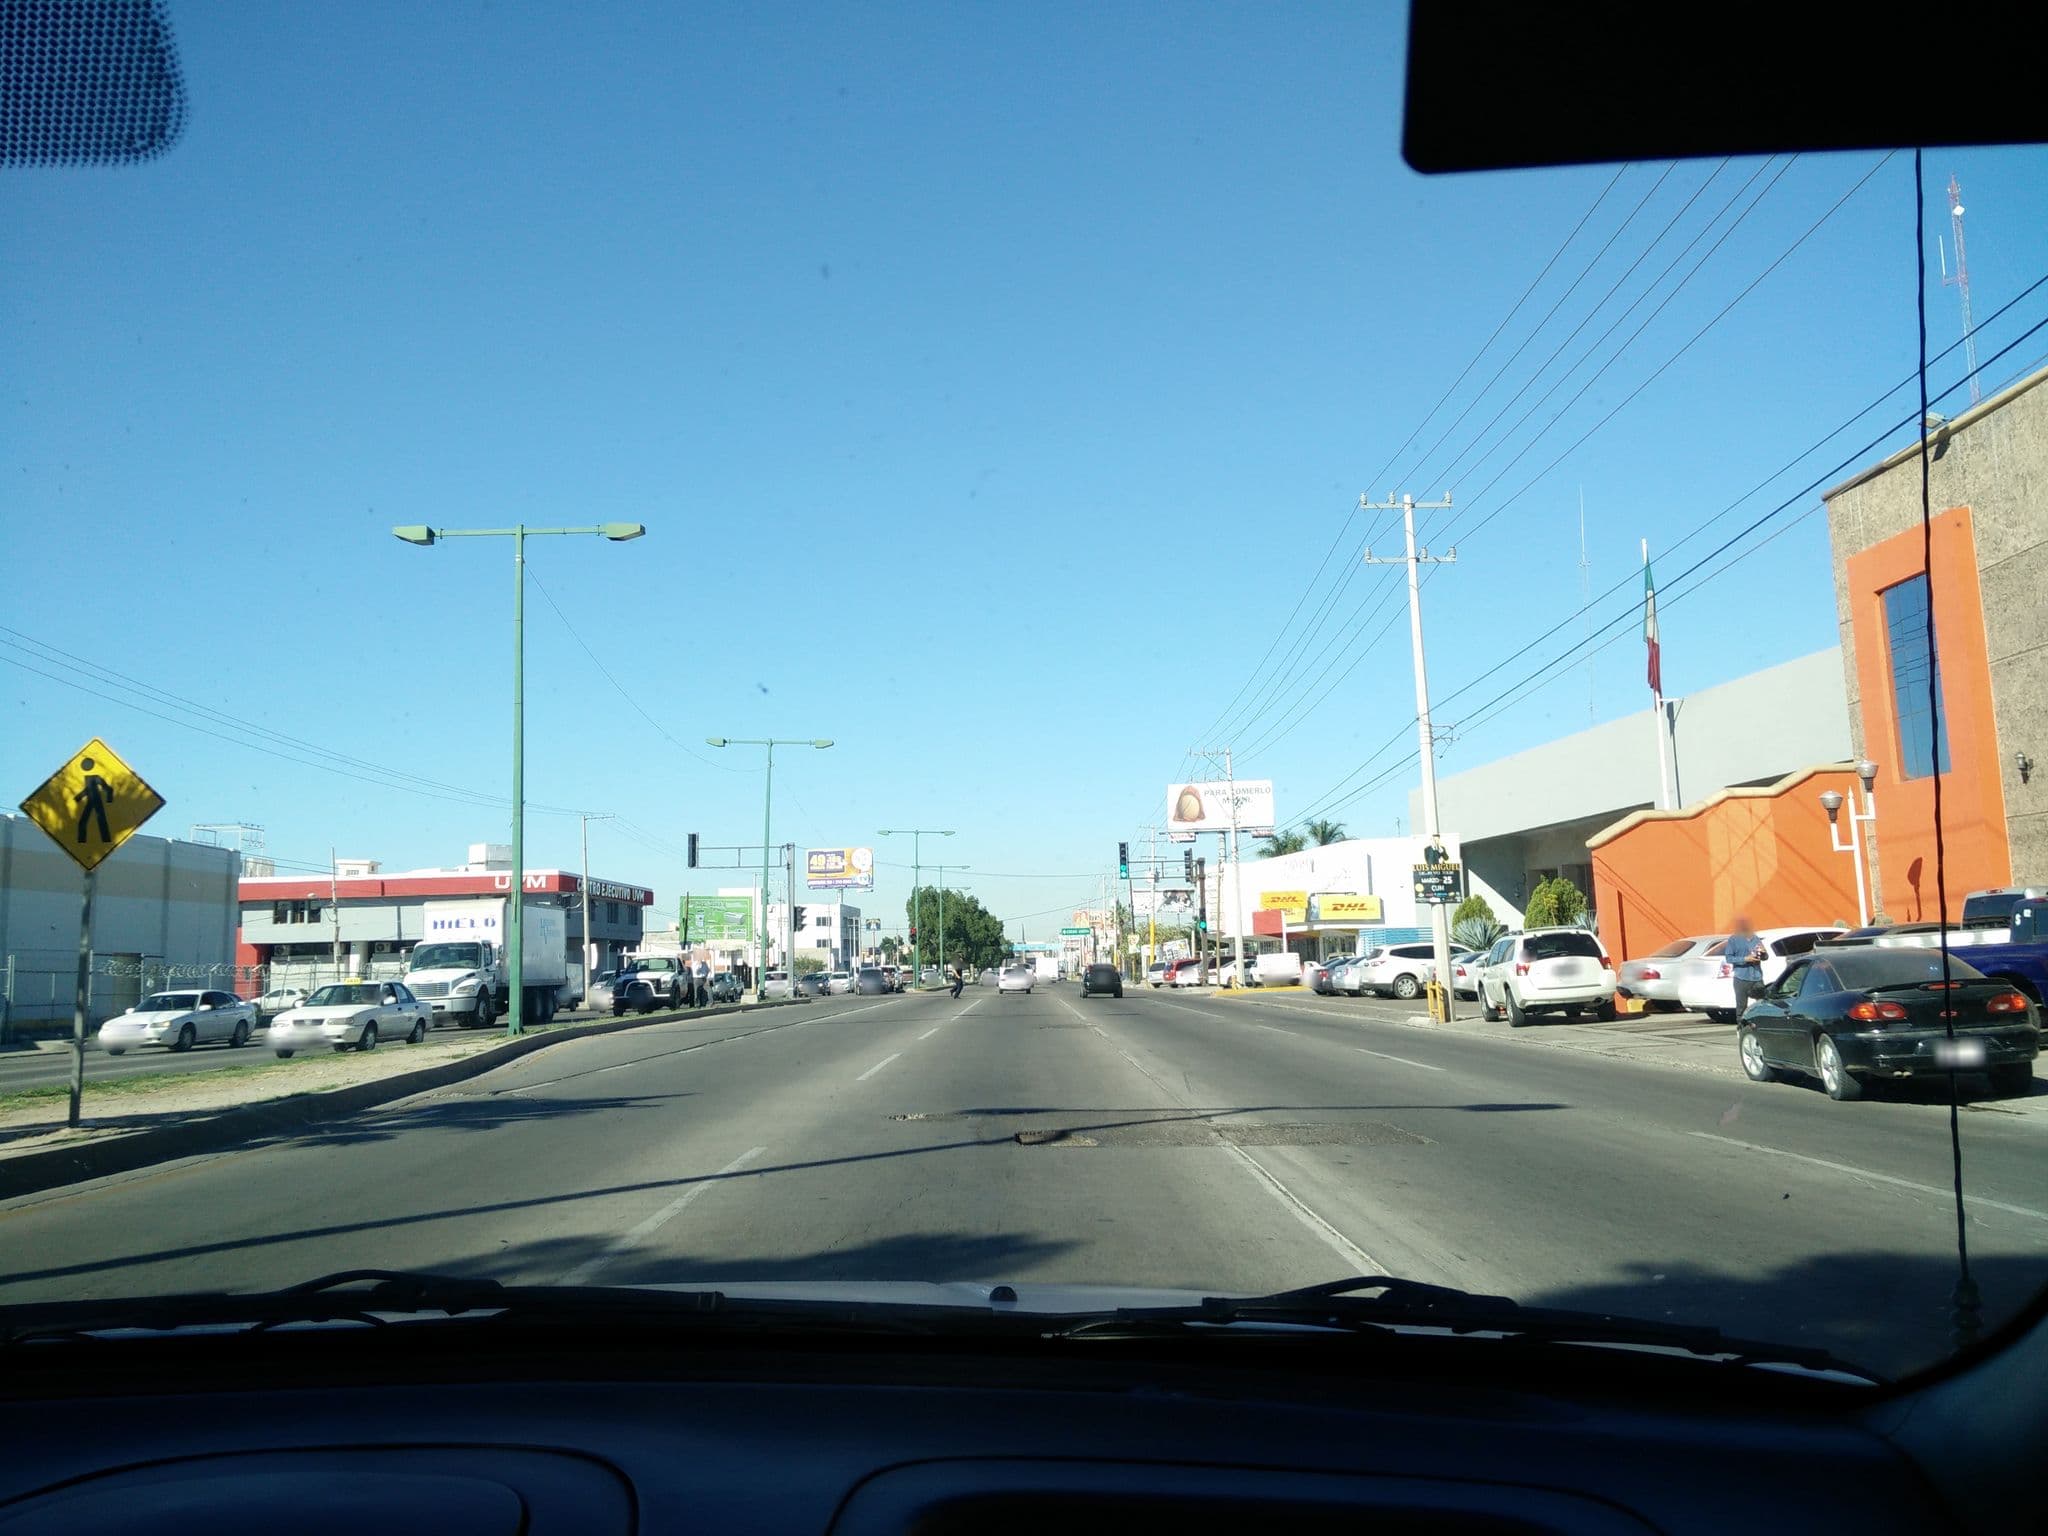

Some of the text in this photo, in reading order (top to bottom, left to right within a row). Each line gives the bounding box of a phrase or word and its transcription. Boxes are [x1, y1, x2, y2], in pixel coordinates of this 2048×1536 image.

[1431, 863, 1461, 871] MIGUEL
[494, 875, 547, 889] UM
[1443, 876, 1453, 884] 25
[1332, 903, 1368, 911] DHL
